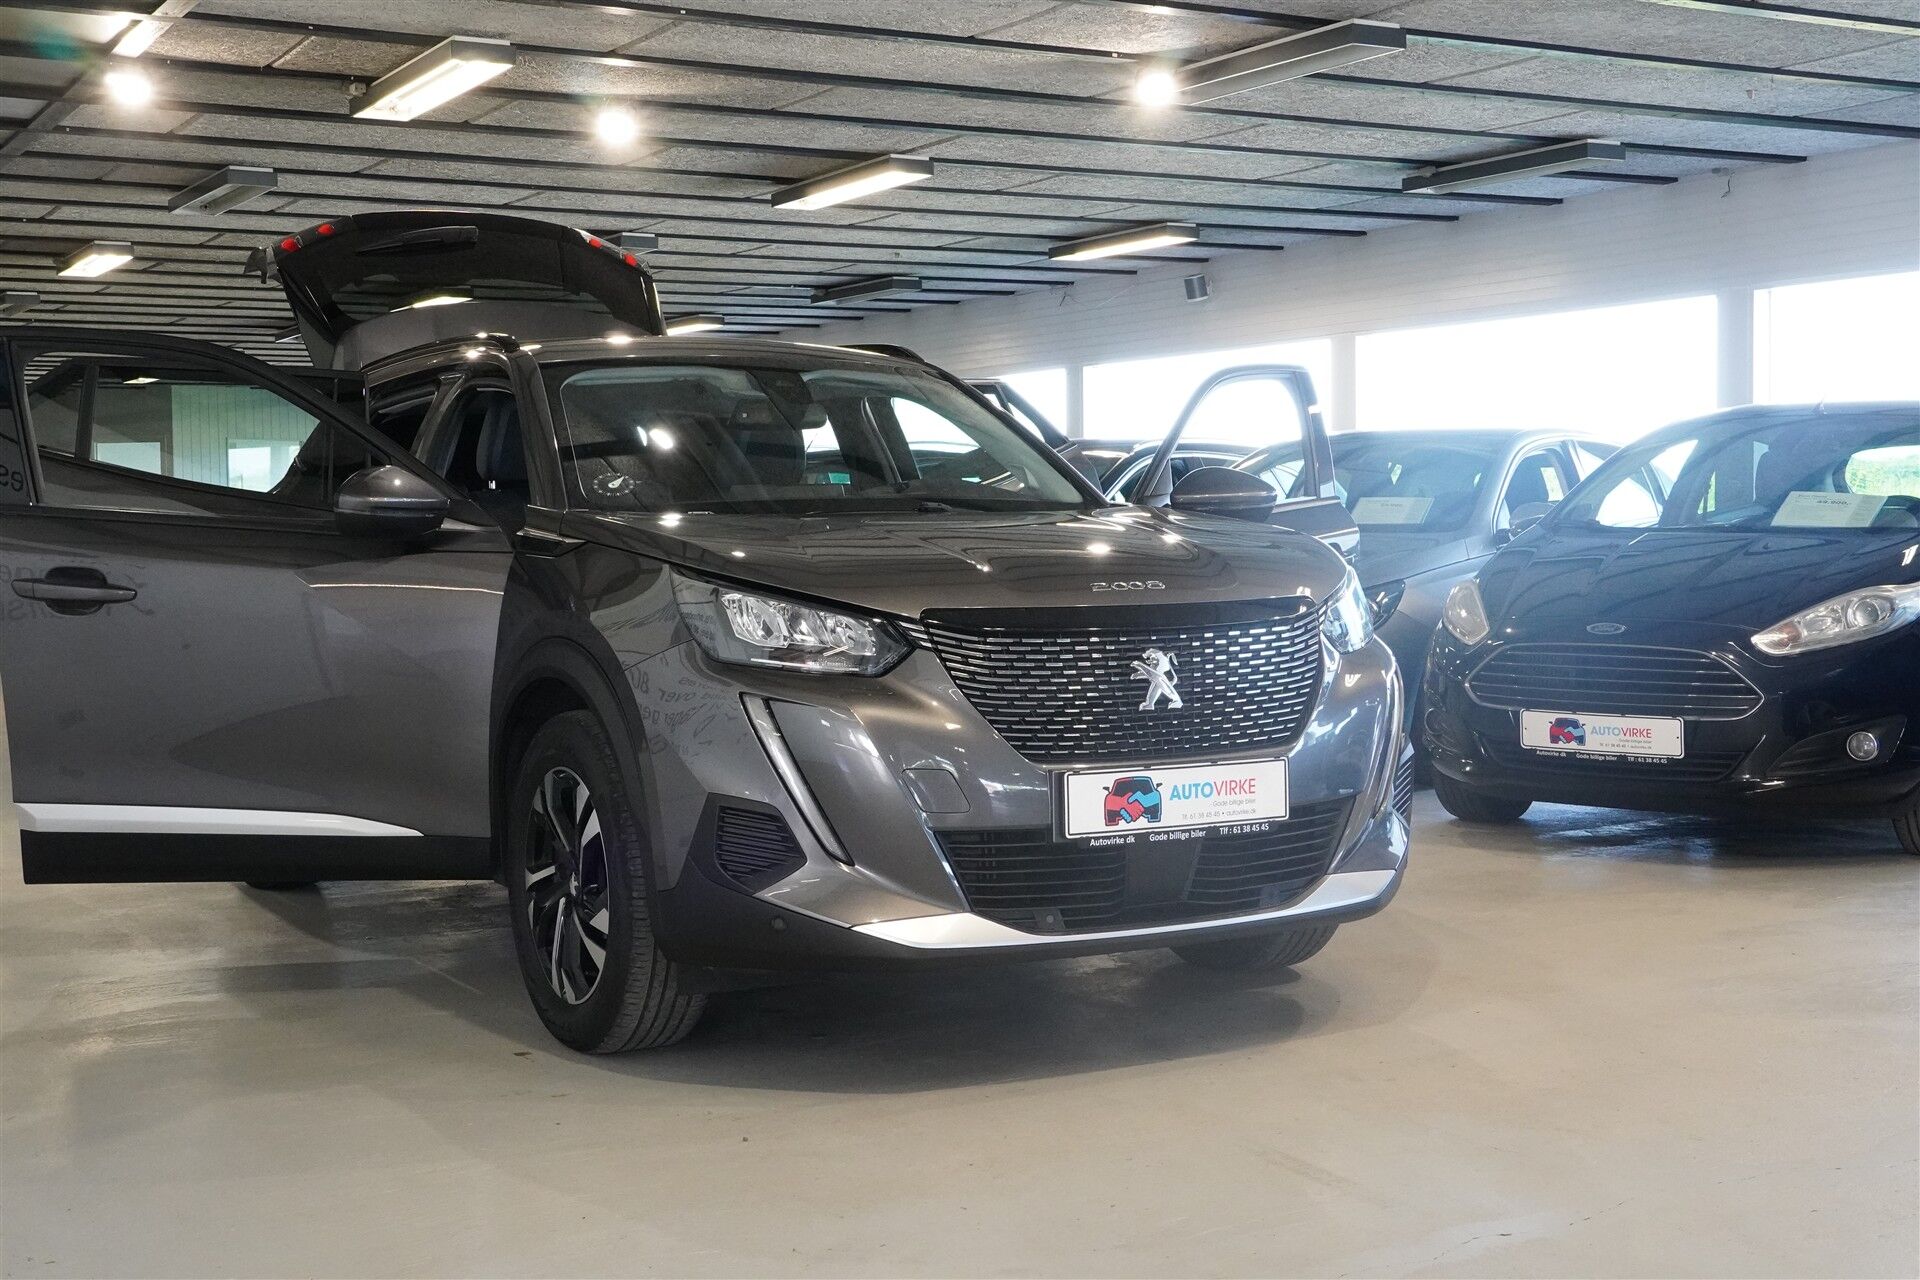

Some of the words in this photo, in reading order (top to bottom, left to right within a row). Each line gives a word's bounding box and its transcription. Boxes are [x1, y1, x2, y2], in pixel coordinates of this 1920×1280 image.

[1090, 580, 1166, 591] 2008
[1591, 726, 1652, 738] AUTOVIRKE
[1170, 778, 1256, 800] AUTOVIRKE
[1090, 837, 1125, 846] Autovirke
[1149, 832, 1168, 841] Gode
[1169, 830, 1190, 841] billige
[1190, 829, 1206, 838] biler
[1233, 826, 1241, 834] 61
[1242, 825, 1250, 833] 38
[1251, 824, 1260, 832] 45
[1261, 823, 1269, 831] 45
